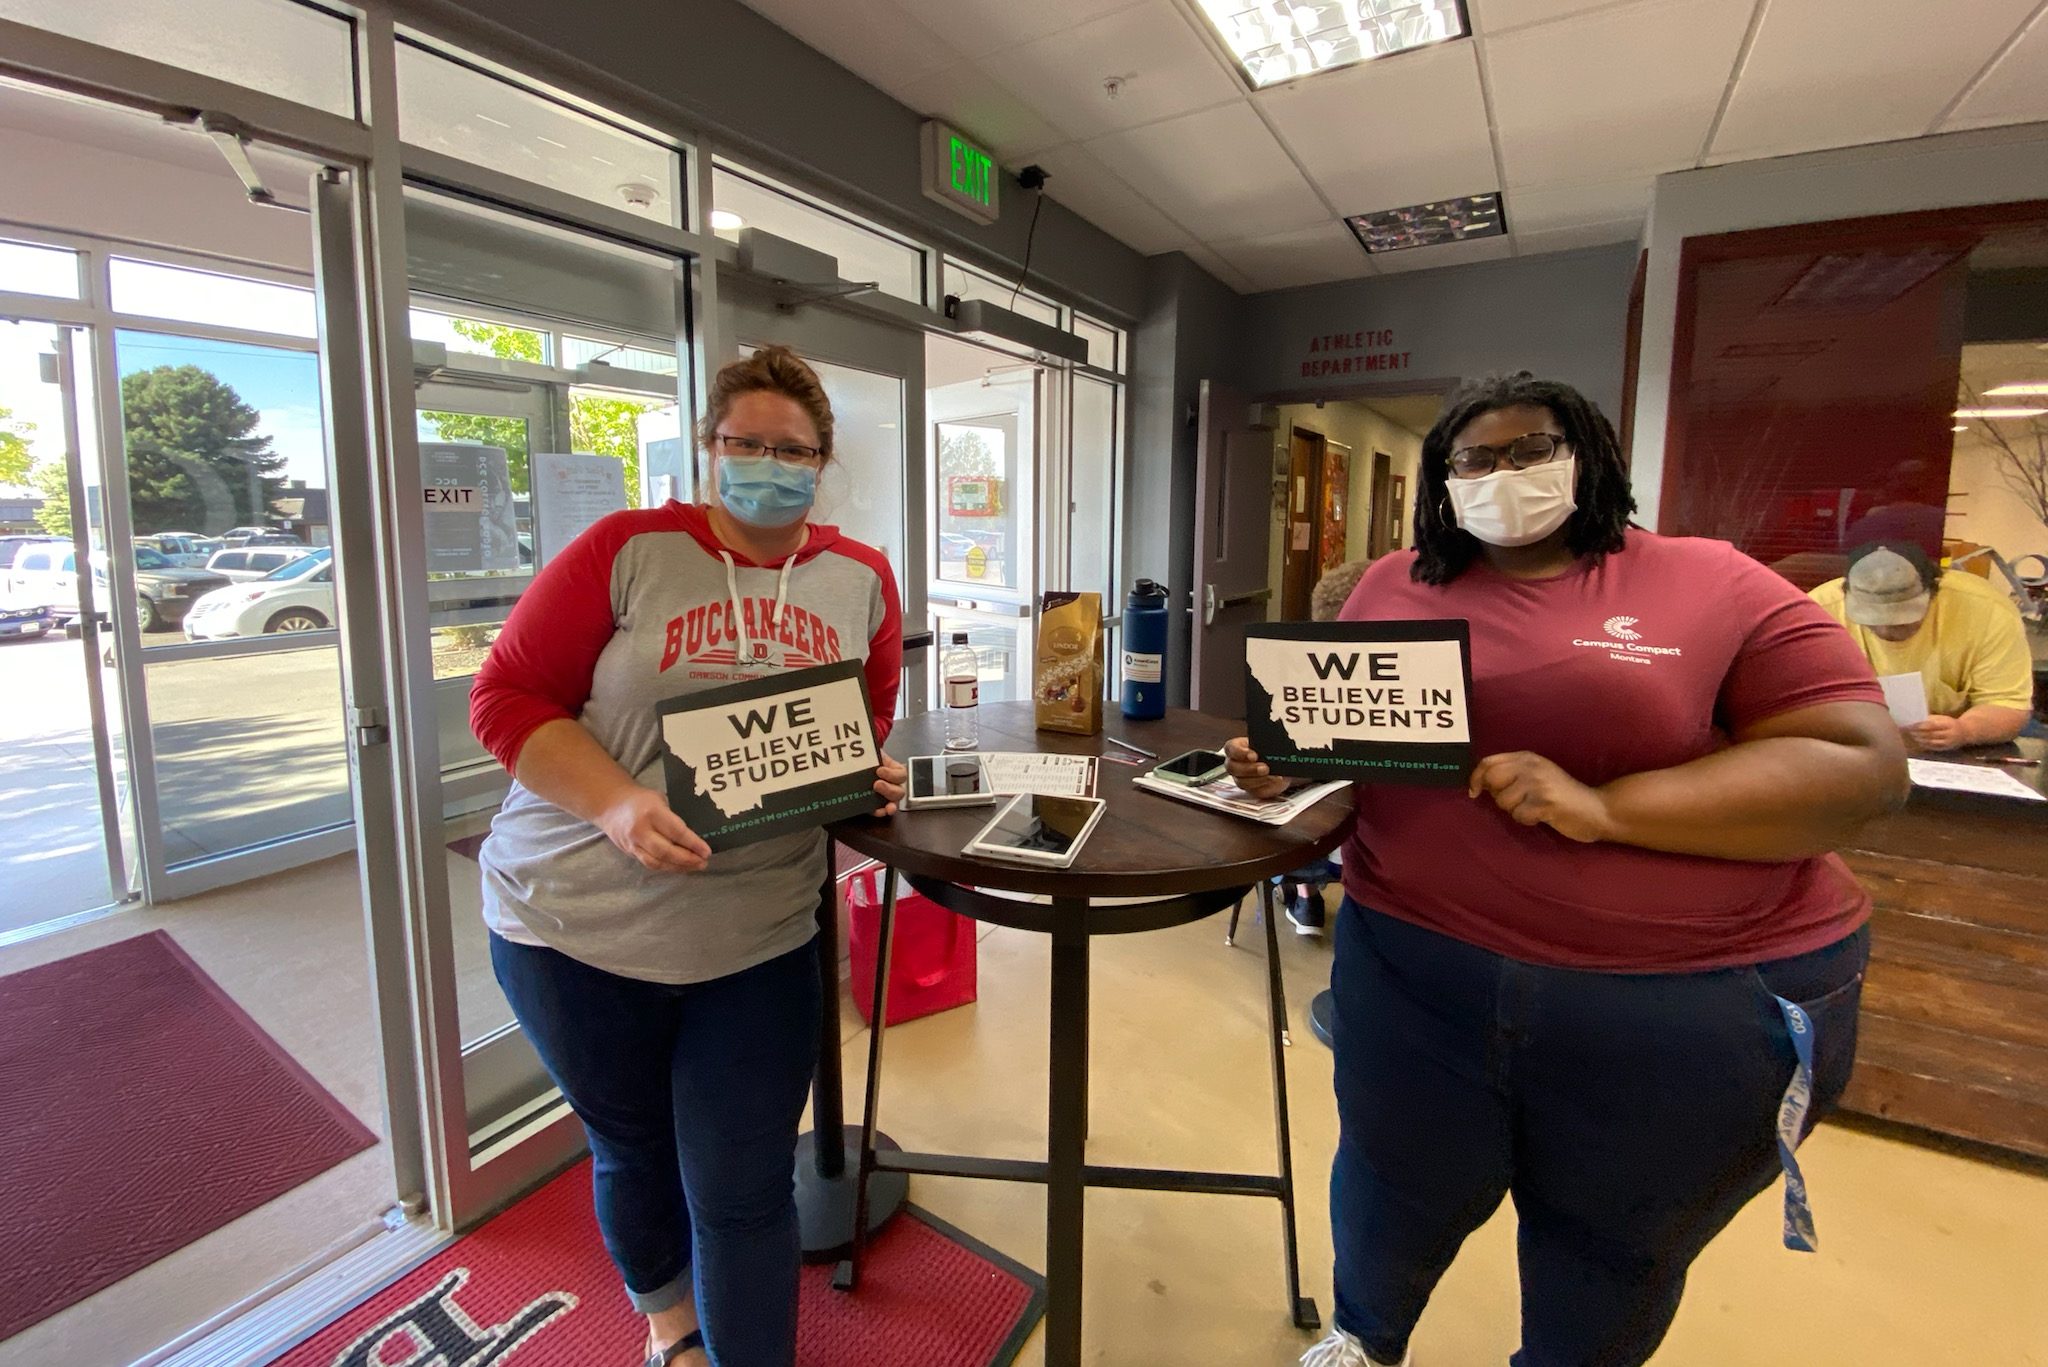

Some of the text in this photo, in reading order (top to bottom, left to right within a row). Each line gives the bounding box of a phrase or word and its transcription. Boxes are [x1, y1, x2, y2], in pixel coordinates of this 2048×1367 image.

[950, 136, 991, 206] EXIT
[1309, 329, 1393, 353] ATHLETIC
[1301, 352, 1411, 378] DEPARTMENT
[424, 488, 473, 503] EXIT
[659, 597, 842, 673] BUCCANEERS
[1573, 638, 1682, 656] Campus Compact
[1307, 652, 1401, 681] WE
[1610, 652, 1652, 664] Montana
[689, 670, 729, 681] DAWSON
[1283, 686, 1452, 706] BELIEVE IN
[727, 698, 816, 739] WE
[1285, 705, 1455, 729] STUDENTS
[706, 720, 862, 772] BELIEVE IN
[710, 740, 866, 792] STUDENTS
[1785, 1003, 1807, 1035] 1920
